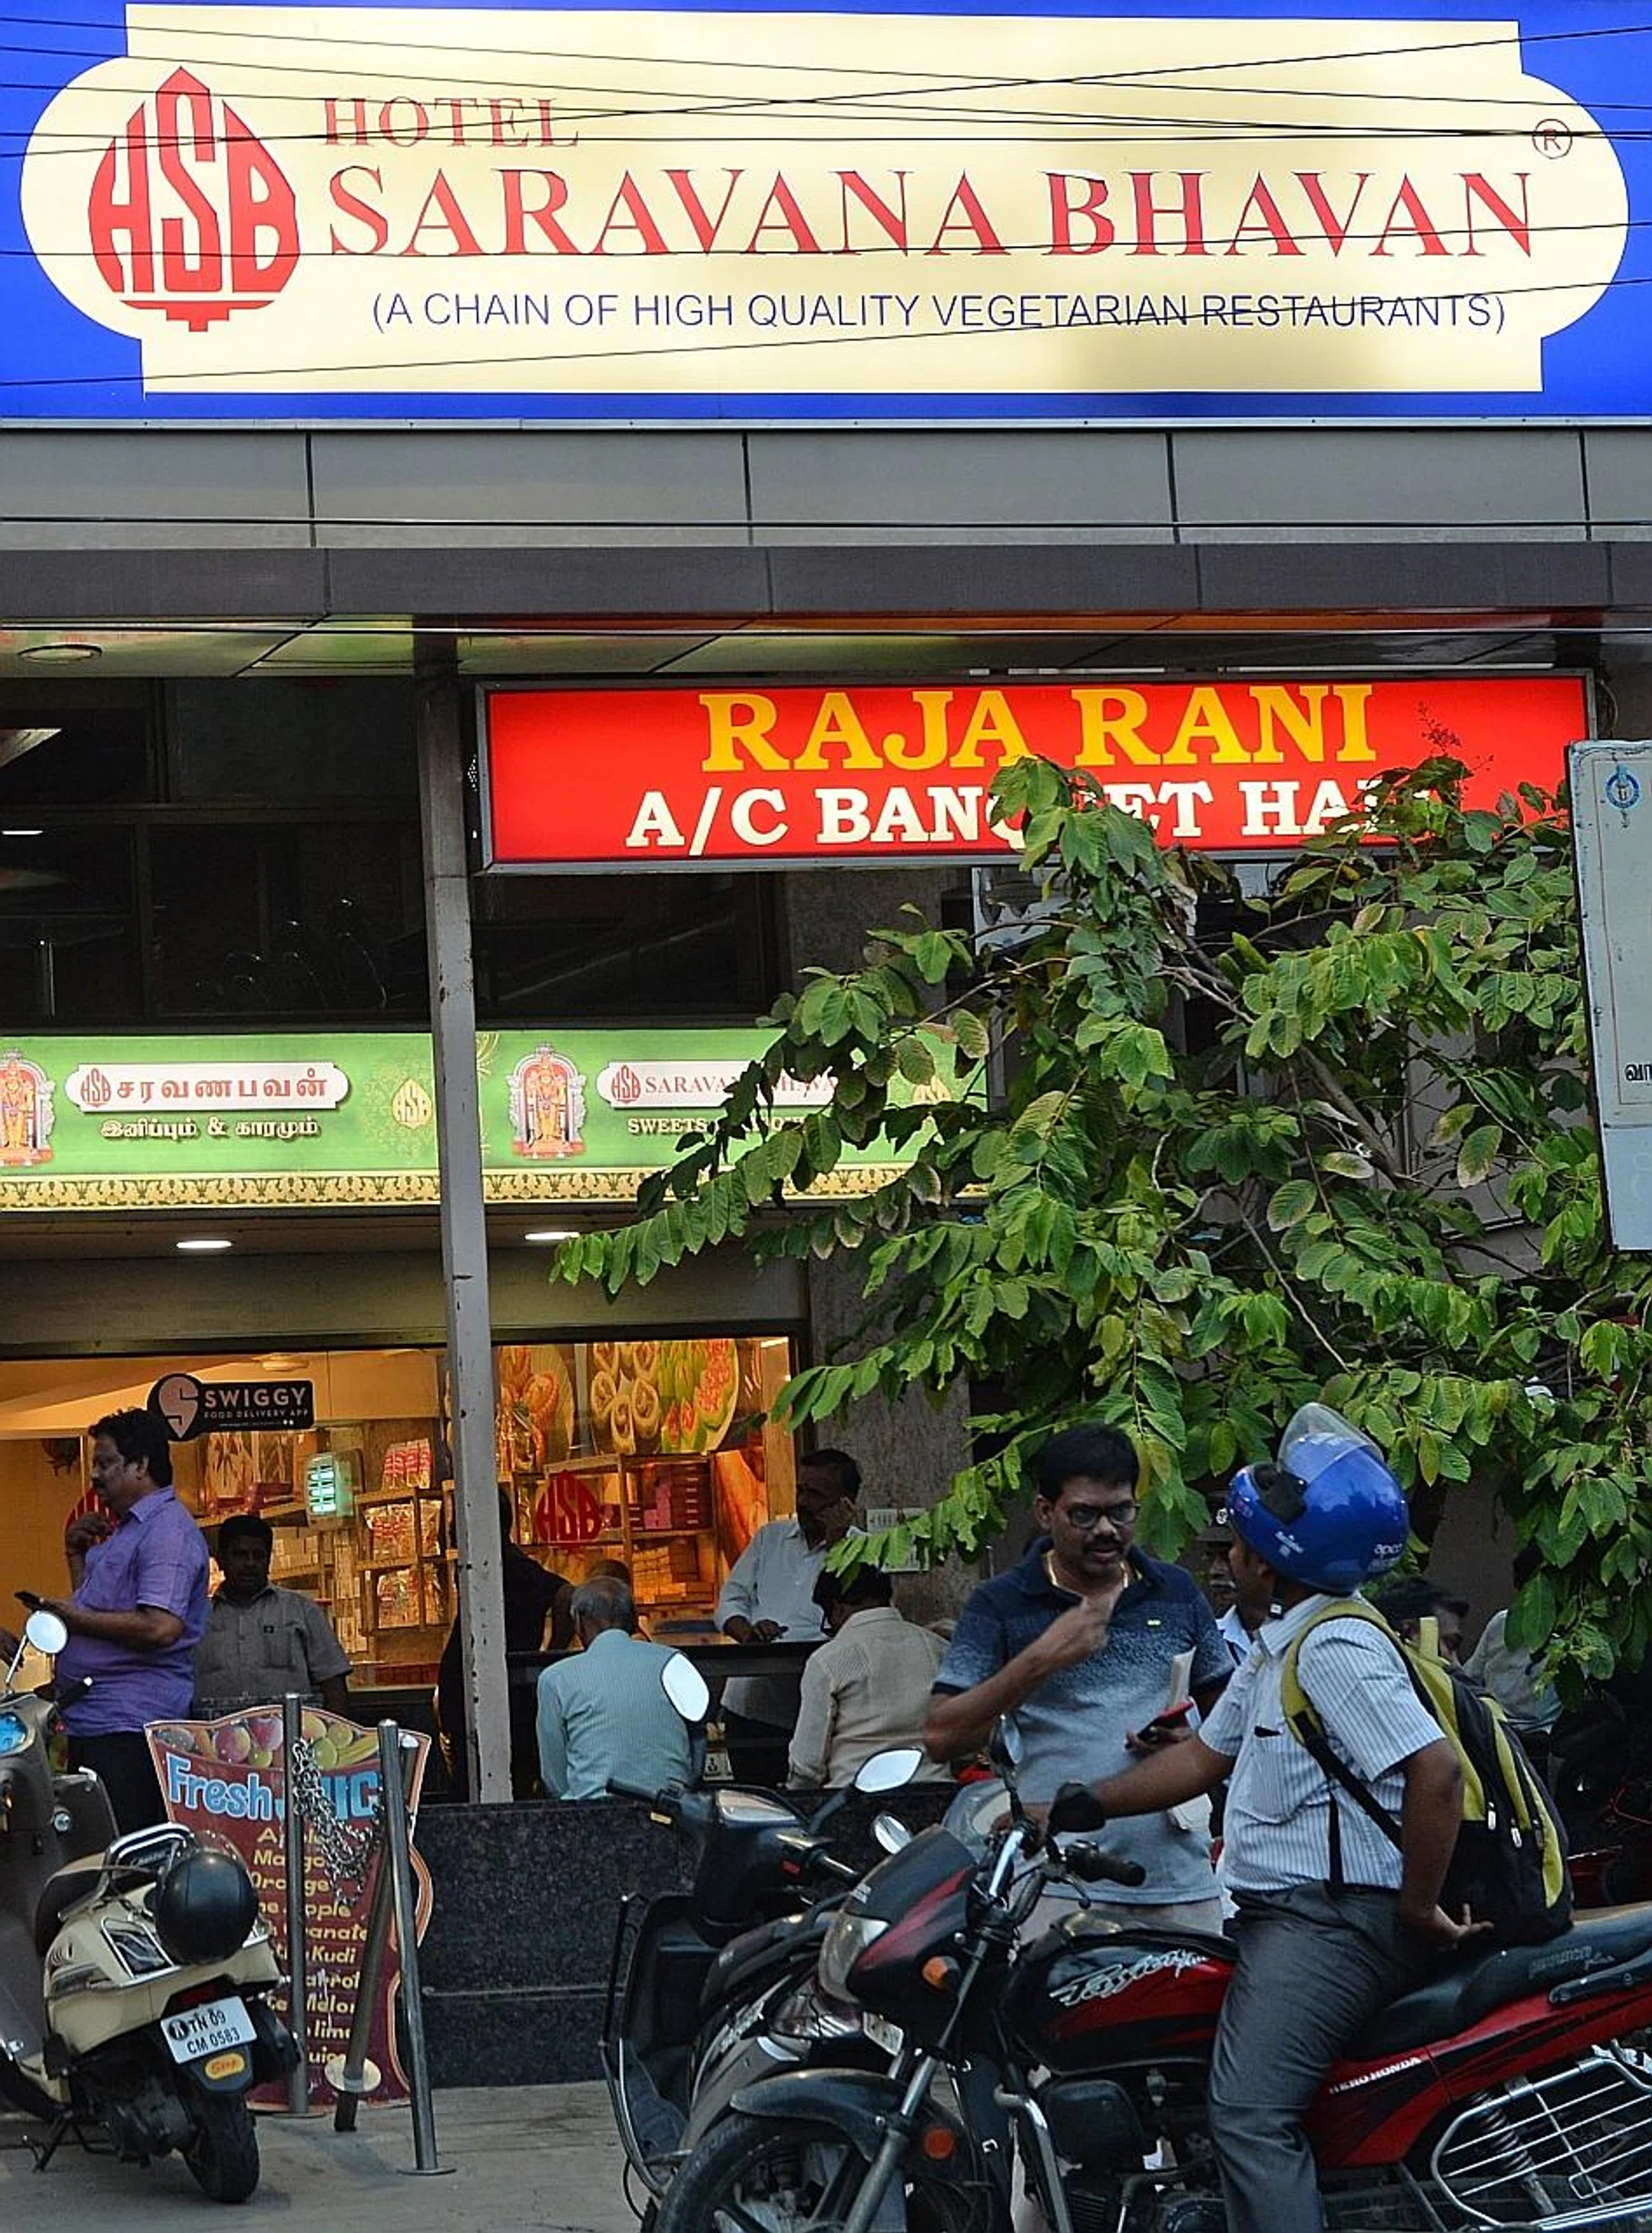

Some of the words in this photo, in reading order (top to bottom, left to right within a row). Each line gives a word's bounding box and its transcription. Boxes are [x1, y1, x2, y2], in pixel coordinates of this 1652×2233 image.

[322, 98, 579, 149] HOTEL
[330, 166, 1012, 256] SARAVANA
[1042, 172, 1532, 257] BHAVAN
[373, 294, 412, 334] (A
[424, 294, 549, 326] CHAIN
[566, 294, 619, 326] OF
[635, 294, 733, 326] HIGH
[749, 294, 920, 330] QUALITY
[933, 294, 1187, 327] VEGETARIAN
[1204, 294, 1506, 334] RESTAURANTS)
[699, 690, 1032, 773] RAJA
[1071, 684, 1377, 766] RANI
[626, 786, 788, 856] A/C
[117, 1067, 327, 1104] சரவணபவன்
[101, 1118, 198, 1139] இனிப்பும்
[207, 1117, 226, 1136] &
[235, 1115, 321, 1138] காரமும்
[628, 1117, 708, 1133] SWEETS
[204, 1387, 306, 1409] SWIGGY
[203, 1411, 233, 1420] FOOD
[236, 1410, 285, 1418] DELIVERY
[289, 1408, 308, 1417] APP
[166, 1752, 272, 1820] Fresh
[253, 1849, 326, 1873] Mago
[250, 1871, 330, 1897] Orage
[311, 1945, 357, 1964] Kudi
[188, 2014, 208, 2033] TN
[187, 2036, 208, 2055] CM
